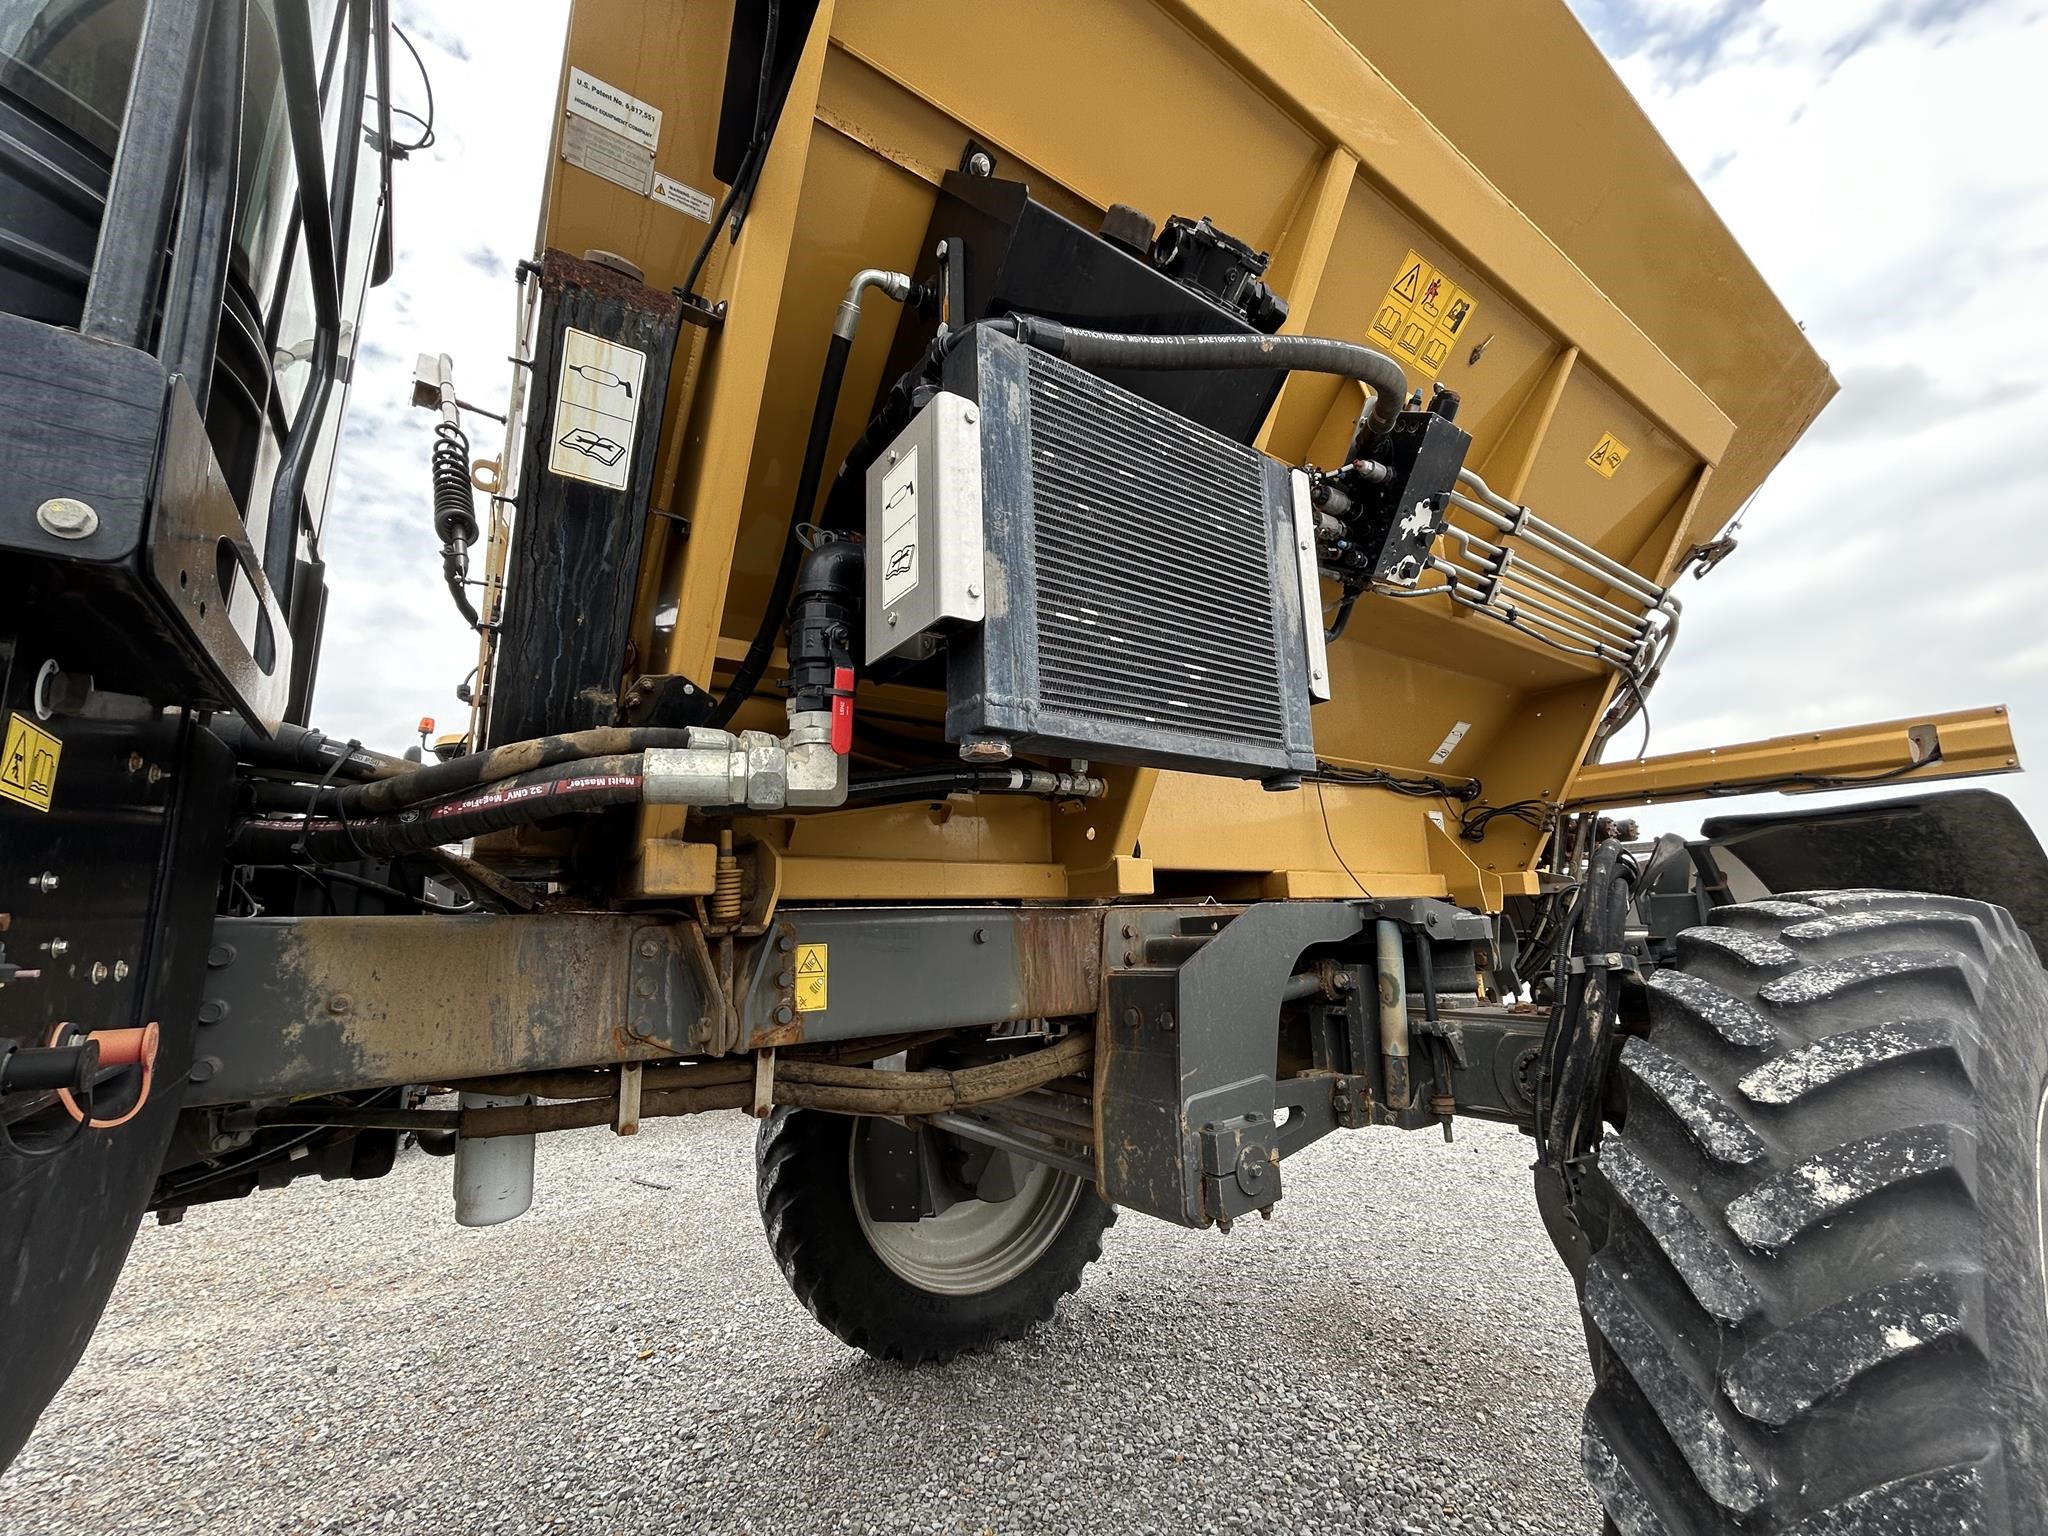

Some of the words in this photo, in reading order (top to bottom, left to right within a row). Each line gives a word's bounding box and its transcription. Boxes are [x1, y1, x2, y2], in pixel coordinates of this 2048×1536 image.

[576, 78, 590, 90] U.S.
[591, 85, 612, 102] Patent
[613, 96, 624, 107] No.
[574, 96, 598, 111] HIGHWAY
[599, 108, 628, 126] EQUIPMENT
[628, 123, 653, 138] COMPANY
[1073, 329, 1104, 340] SUCTION
[1104, 333, 1126, 342] HOSE
[1126, 335, 1150, 343] MSHA
[606, 777, 635, 786] Multi
[529, 785, 543, 795] 32
